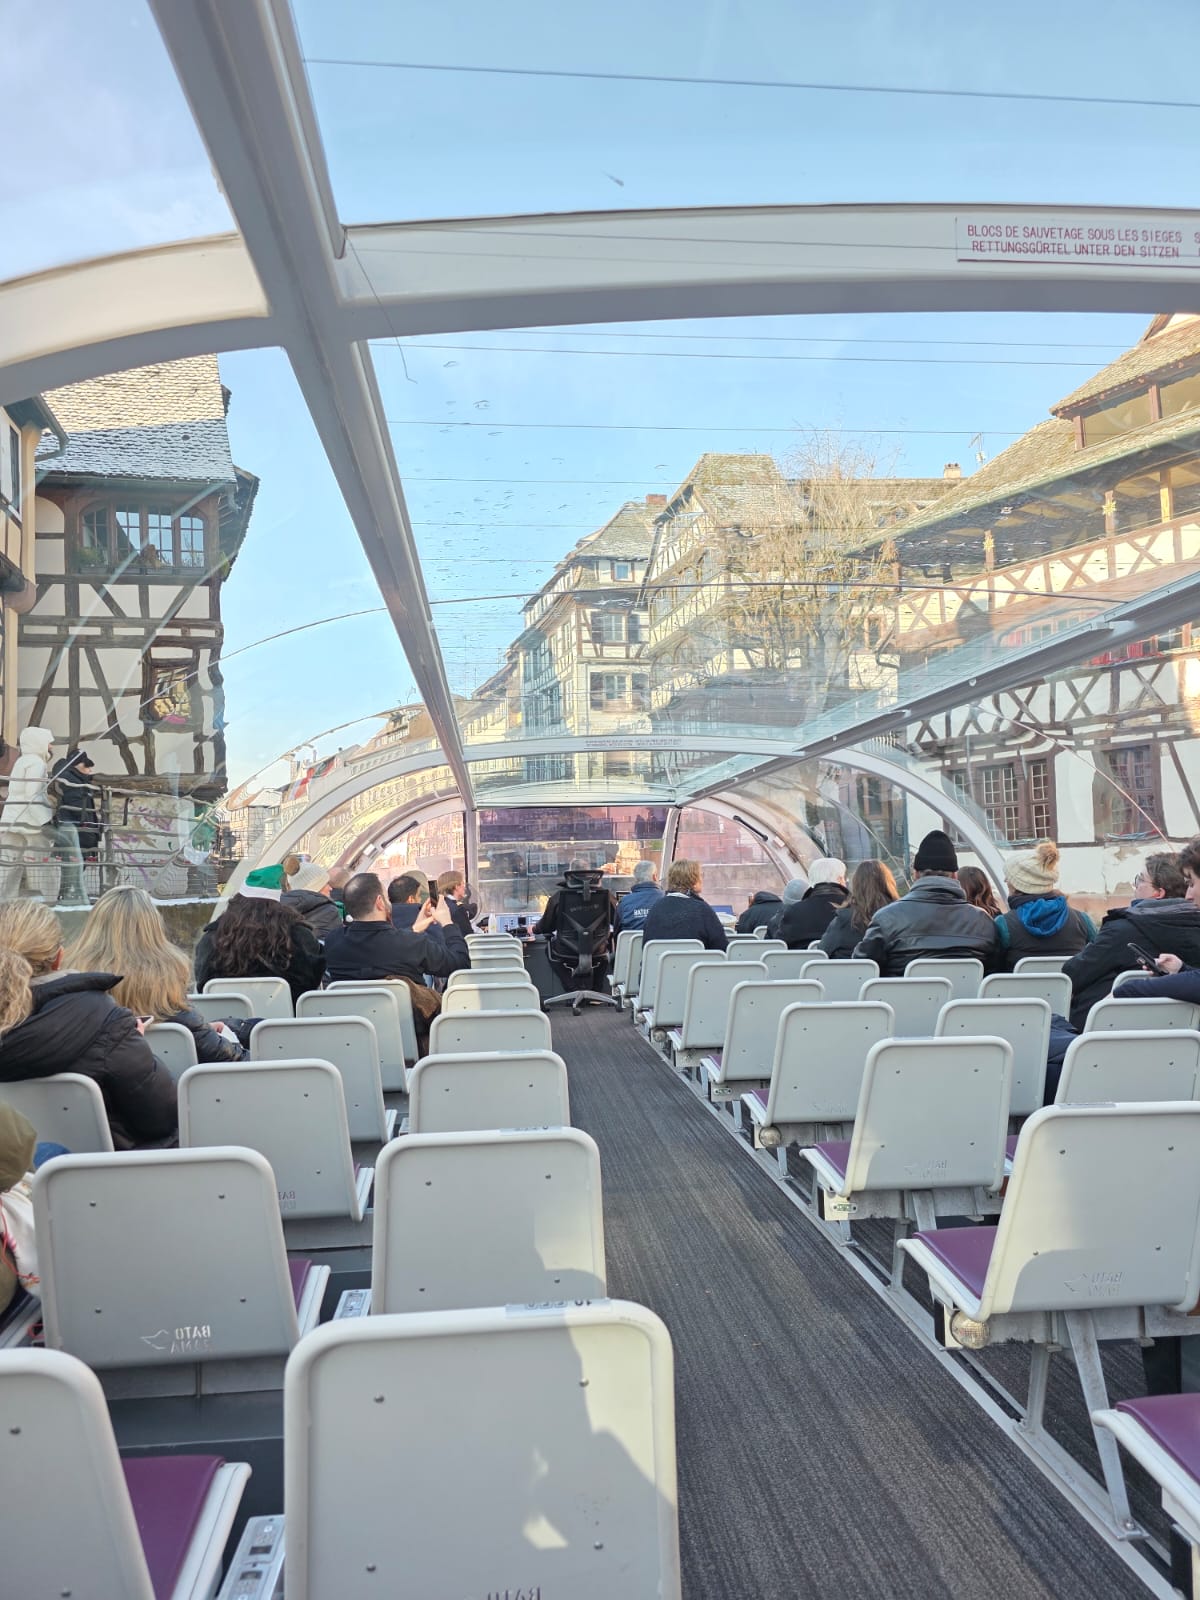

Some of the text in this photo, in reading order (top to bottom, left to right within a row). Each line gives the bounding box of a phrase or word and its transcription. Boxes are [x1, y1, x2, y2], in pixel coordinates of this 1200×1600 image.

[967, 224, 1183, 244] BLOCS DE SAUVETAGE SOUS LES SIEGES
[972, 239, 1180, 258] RETTUNGSGÜRTEL UNTER DEN SITZEN
